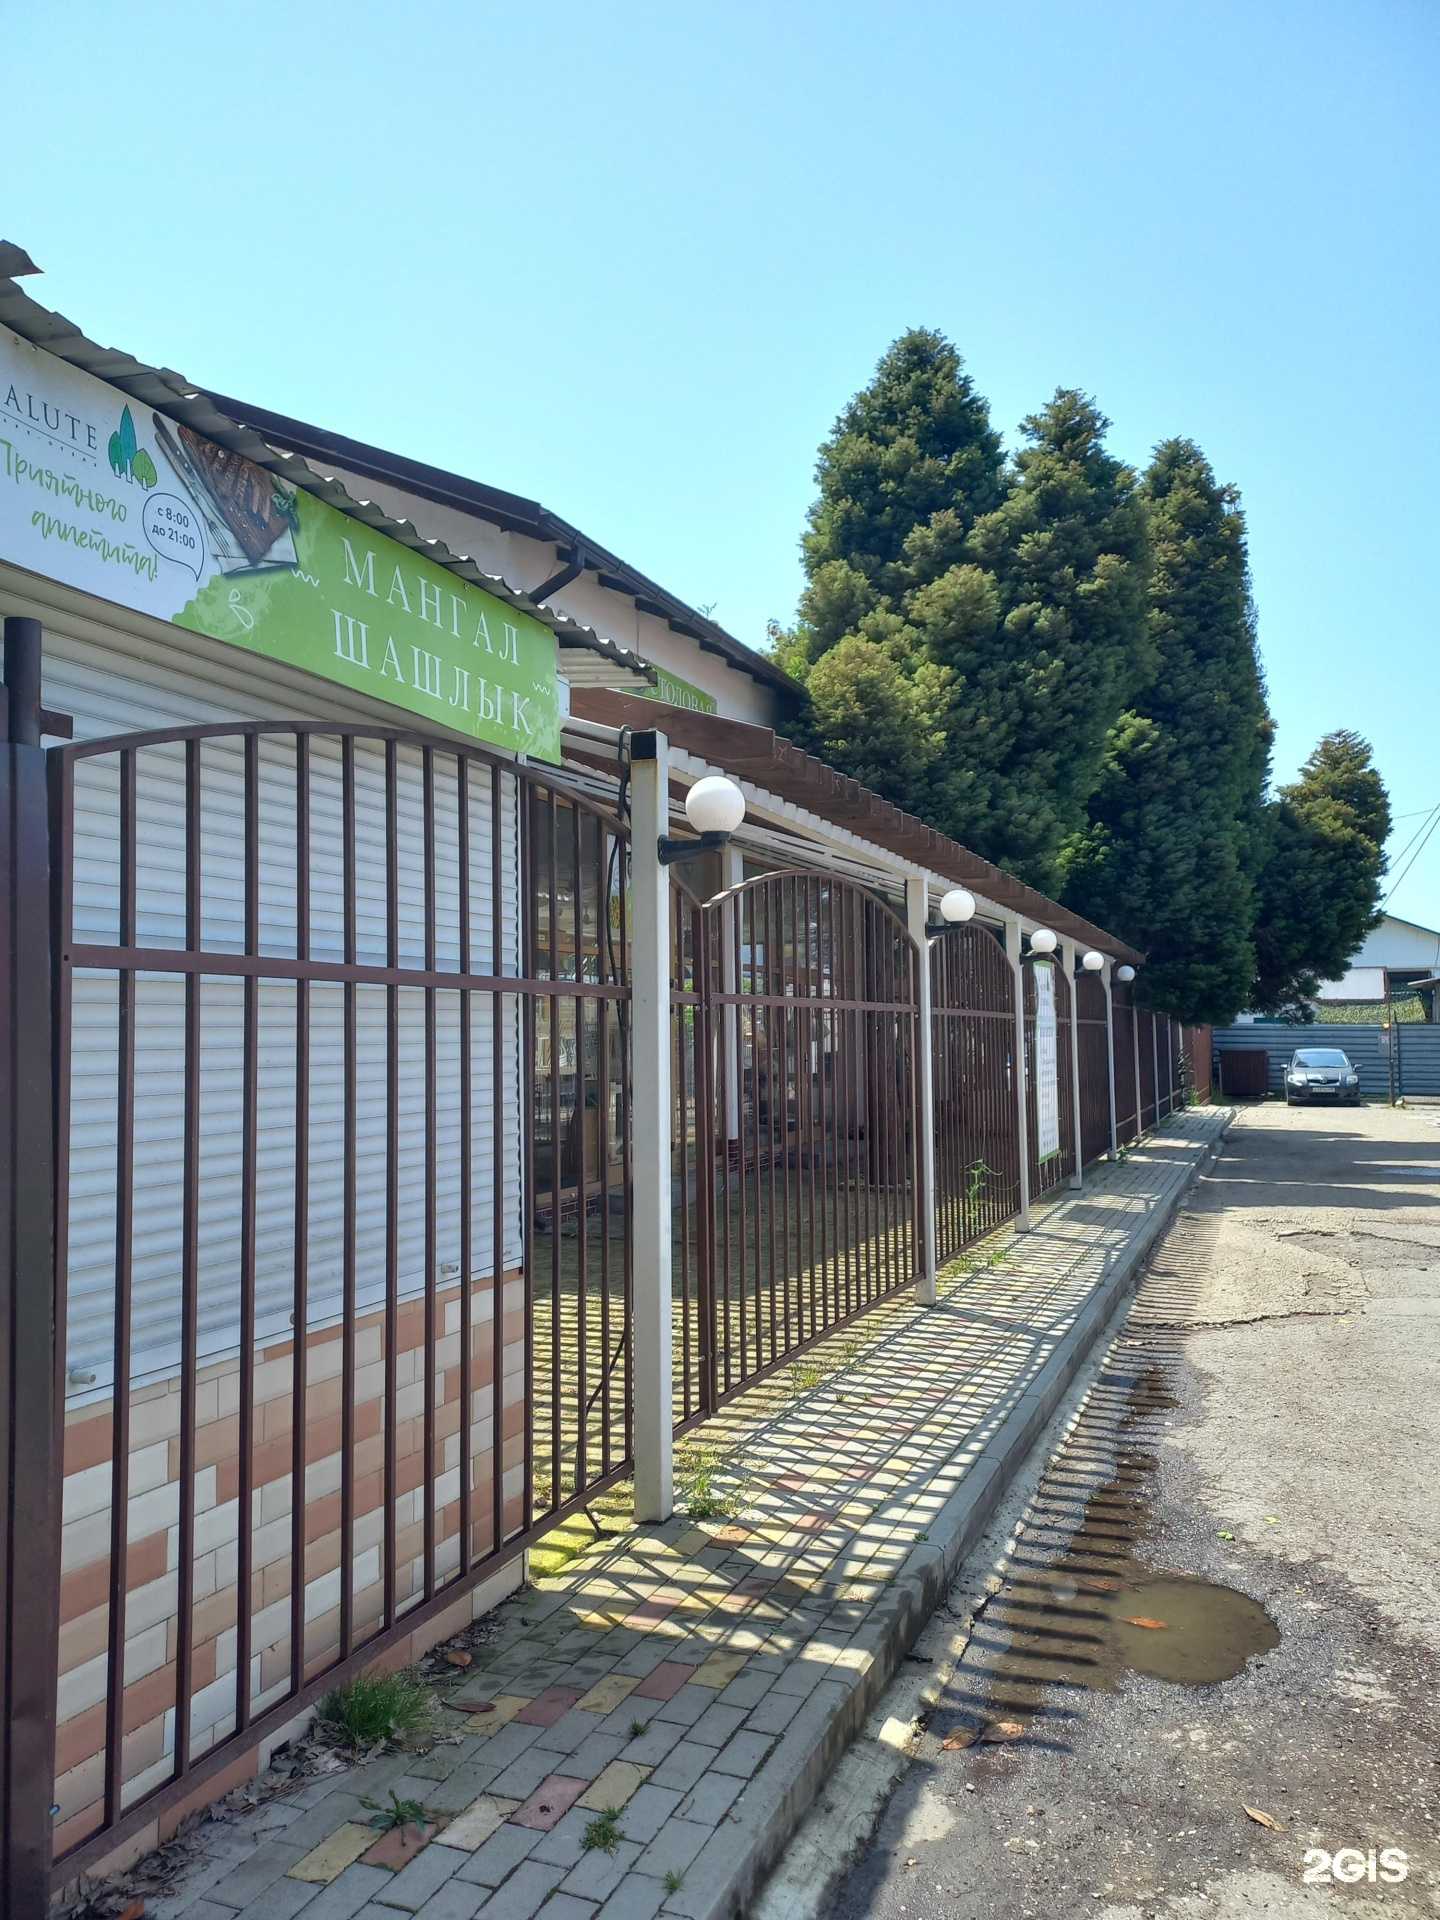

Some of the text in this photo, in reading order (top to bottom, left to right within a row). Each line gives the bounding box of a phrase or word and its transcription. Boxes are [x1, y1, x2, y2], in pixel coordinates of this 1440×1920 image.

[31, 510, 159, 582] аппетита!
[152, 524, 195, 549] до 21:00
[157, 506, 189, 528] с 8:00
[341, 536, 520, 666] МАНГАЛ
[330, 608, 534, 736] ШАШЛЫК
